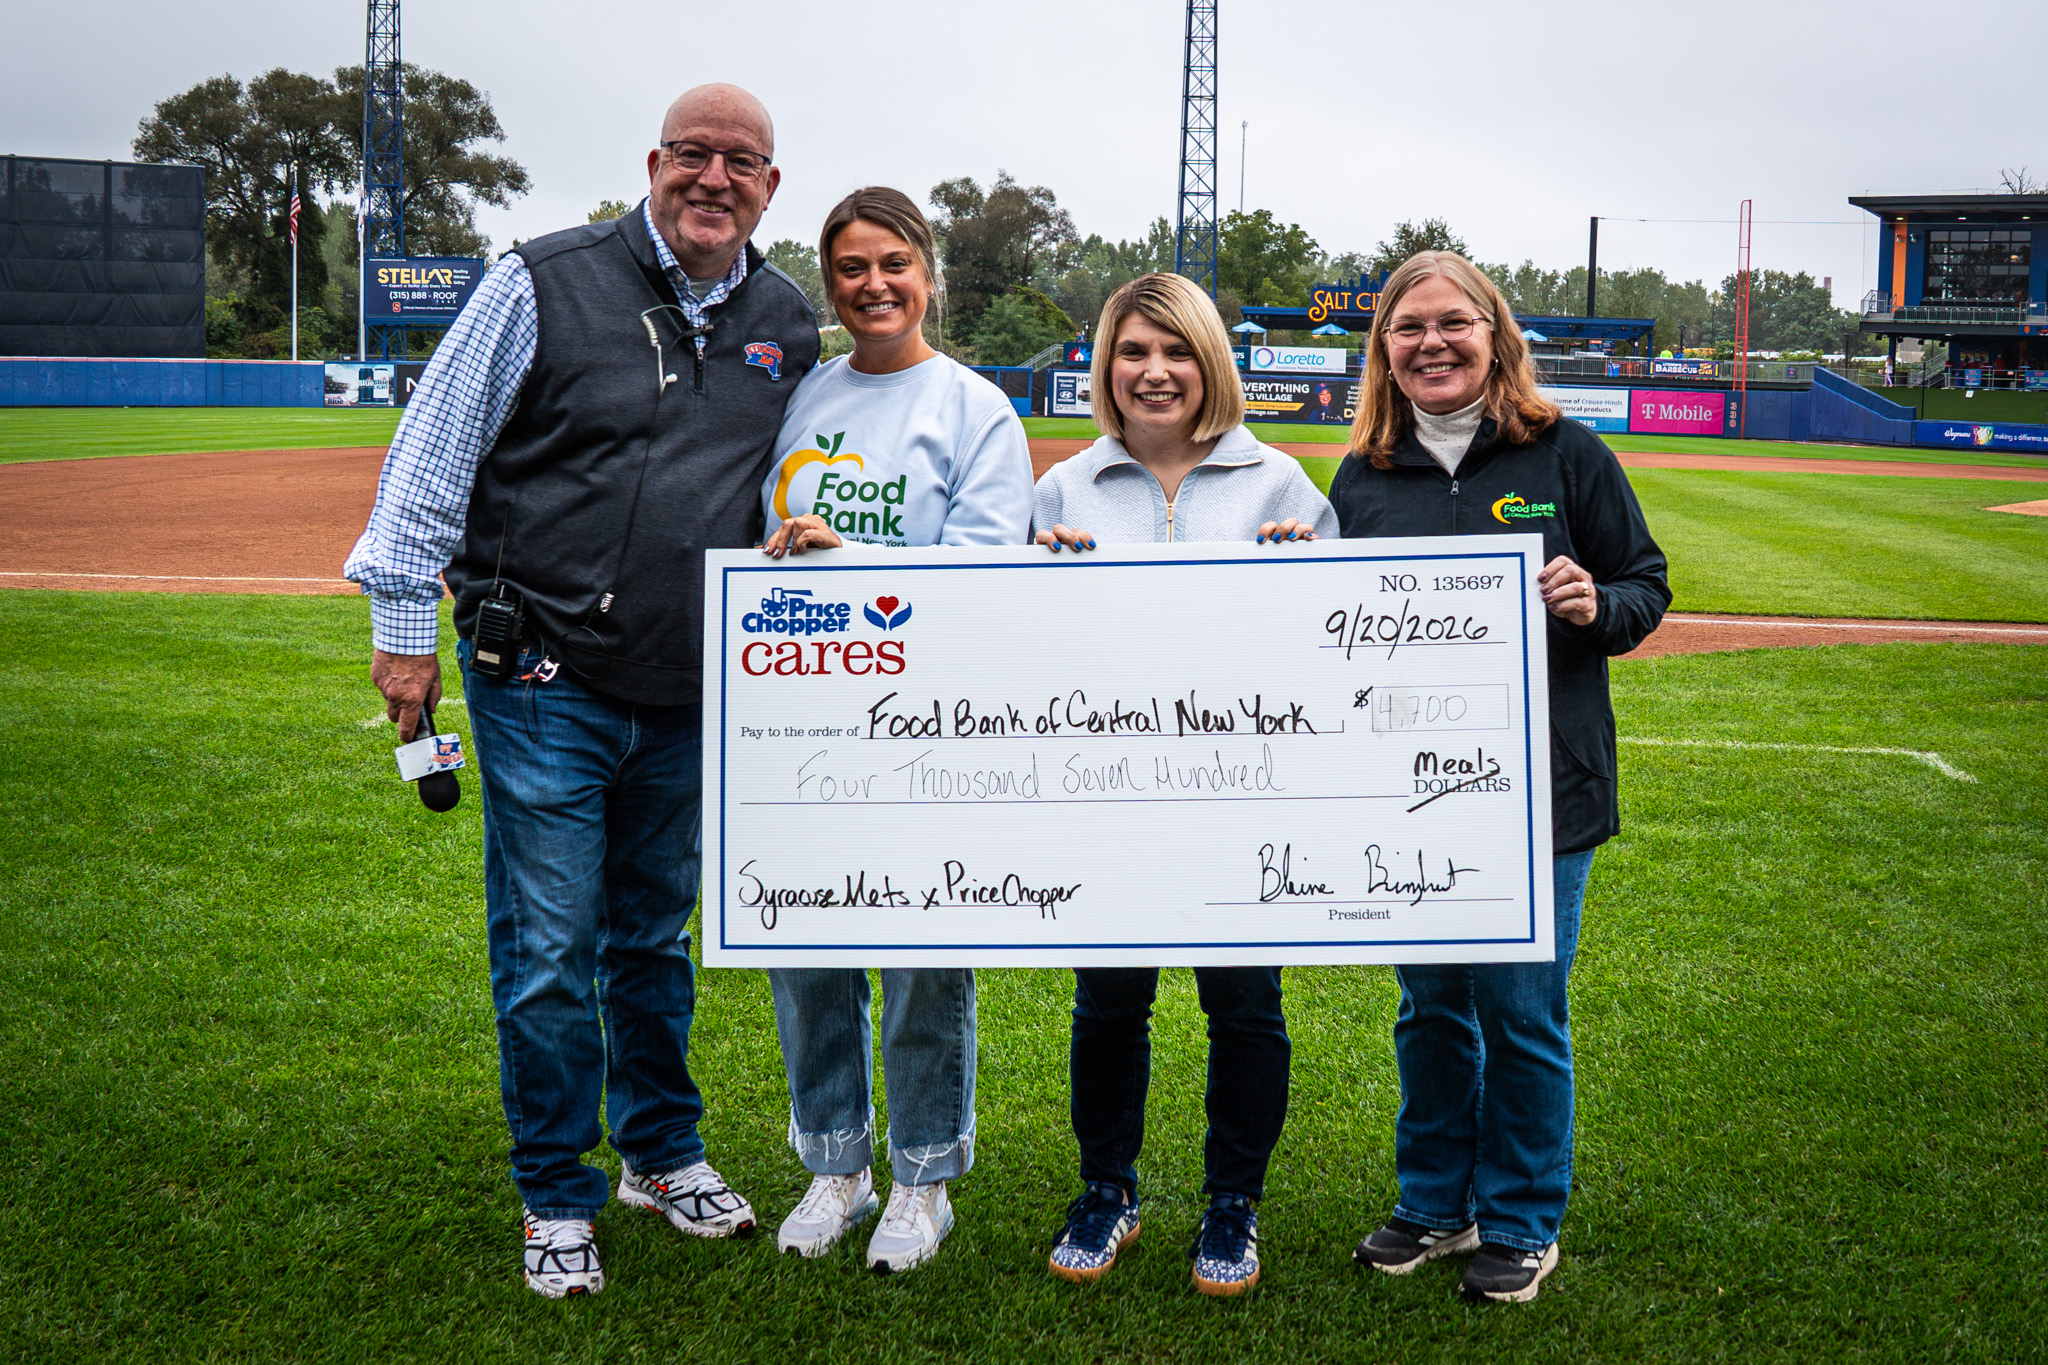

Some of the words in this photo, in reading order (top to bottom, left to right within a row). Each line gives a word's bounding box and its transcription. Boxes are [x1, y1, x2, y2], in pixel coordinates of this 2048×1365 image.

[378, 268, 453, 285] STELLAR
[389, 291, 410, 300] (315)
[1308, 290, 1352, 322] SALT
[1277, 351, 1326, 366] Loretto
[1242, 382, 1310, 394] VERYTHING
[1255, 393, 1293, 402] VILLAGE
[1659, 404, 1713, 421] Mobile
[816, 472, 907, 505] Food
[1504, 505, 1530, 513] Food
[1531, 502, 1556, 511] Bank
[812, 502, 905, 537] Bank
[1379, 574, 1421, 593] NO.
[1433, 575, 1504, 592] 135697
[788, 597, 851, 618] Price
[741, 612, 850, 636] Chopper
[1325, 598, 1489, 660] 9/20/2026
[741, 640, 906, 676] cares
[868, 691, 942, 739] Food
[953, 698, 1024, 737] Bank
[1035, 696, 1061, 735] of
[1066, 690, 1161, 735] Central
[1175, 690, 1235, 737] New
[1239, 694, 1317, 735] York
[741, 727, 764, 739] Pay
[767, 727, 781, 737] to
[784, 726, 805, 737] the
[808, 726, 843, 737] order
[846, 726, 860, 737] of
[797, 749, 878, 801] Four
[893, 749, 1041, 800] Thousand
[1062, 752, 1145, 794] Seven
[1155, 743, 1285, 792] Hundred
[1414, 748, 1501, 777] Meals
[1413, 778, 1511, 794] DOLLARS
[1328, 908, 1391, 920] President
